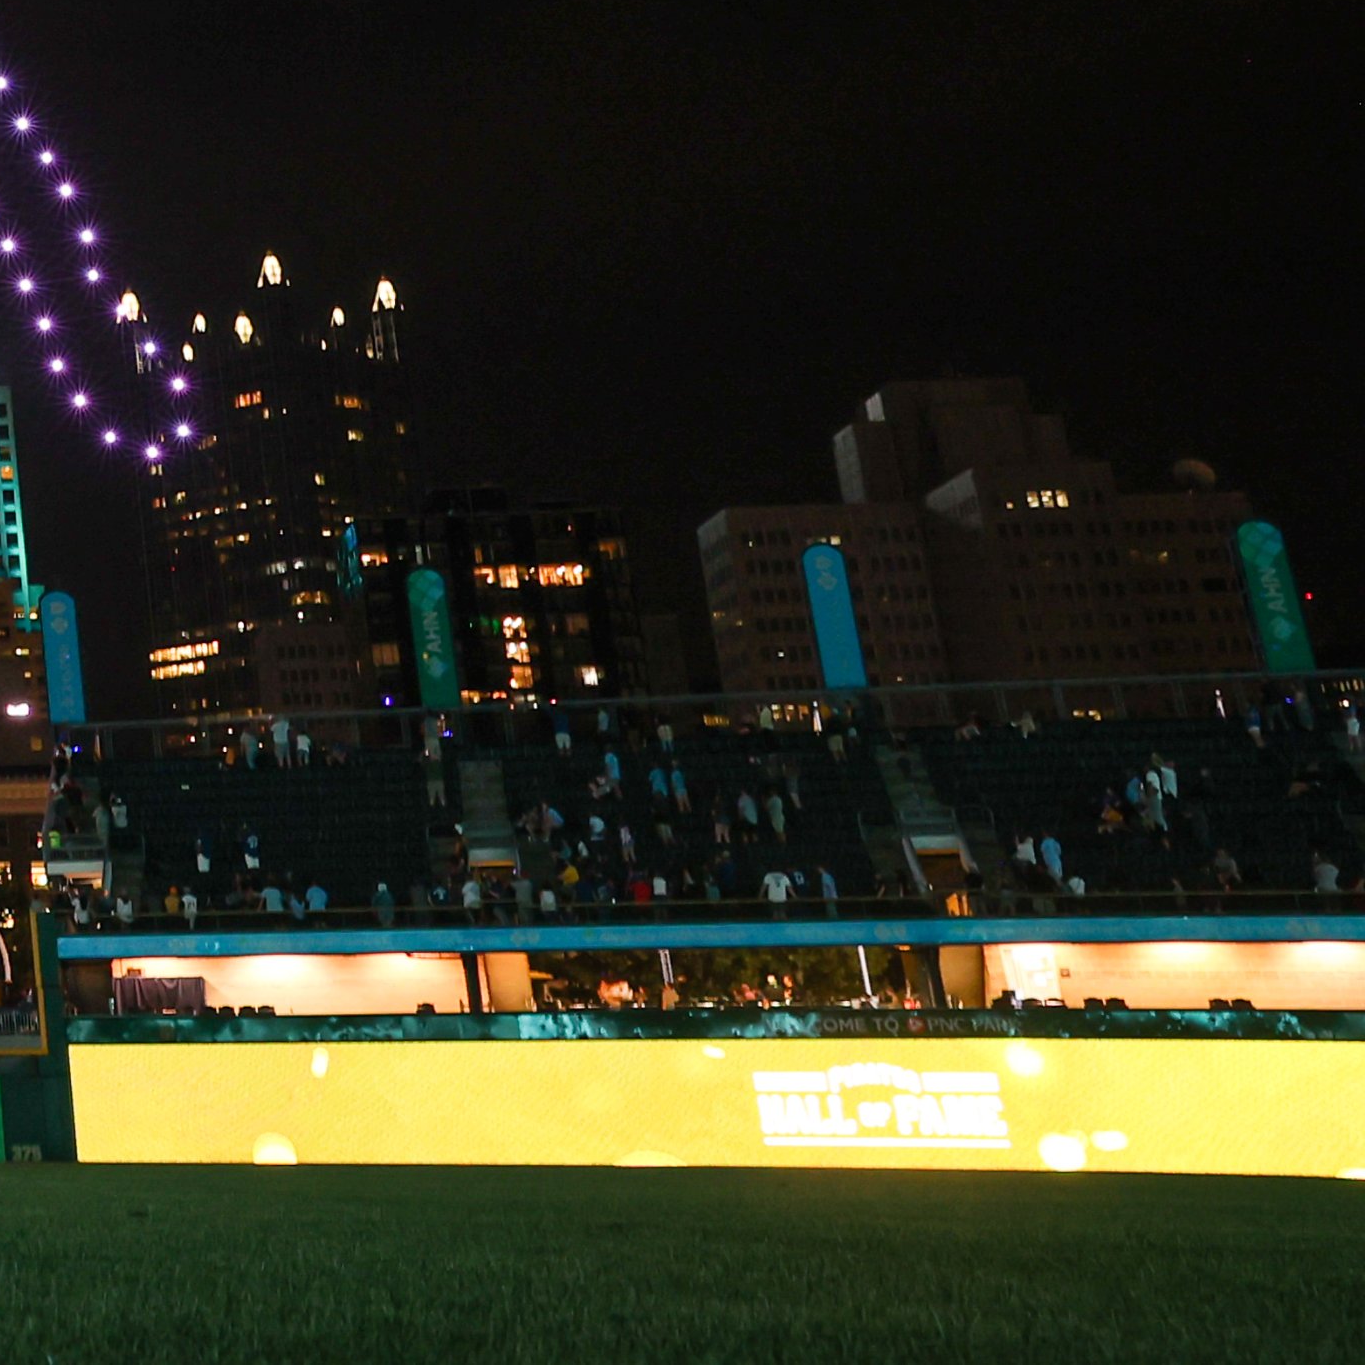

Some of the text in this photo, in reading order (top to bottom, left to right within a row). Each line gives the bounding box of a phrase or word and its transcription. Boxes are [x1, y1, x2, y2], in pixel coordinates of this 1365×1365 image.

[1258, 567, 1288, 614] AHN
[421, 611, 443, 652] AHN
[926, 1015, 966, 1033] PNC
[757, 1094, 858, 1136] HALL
